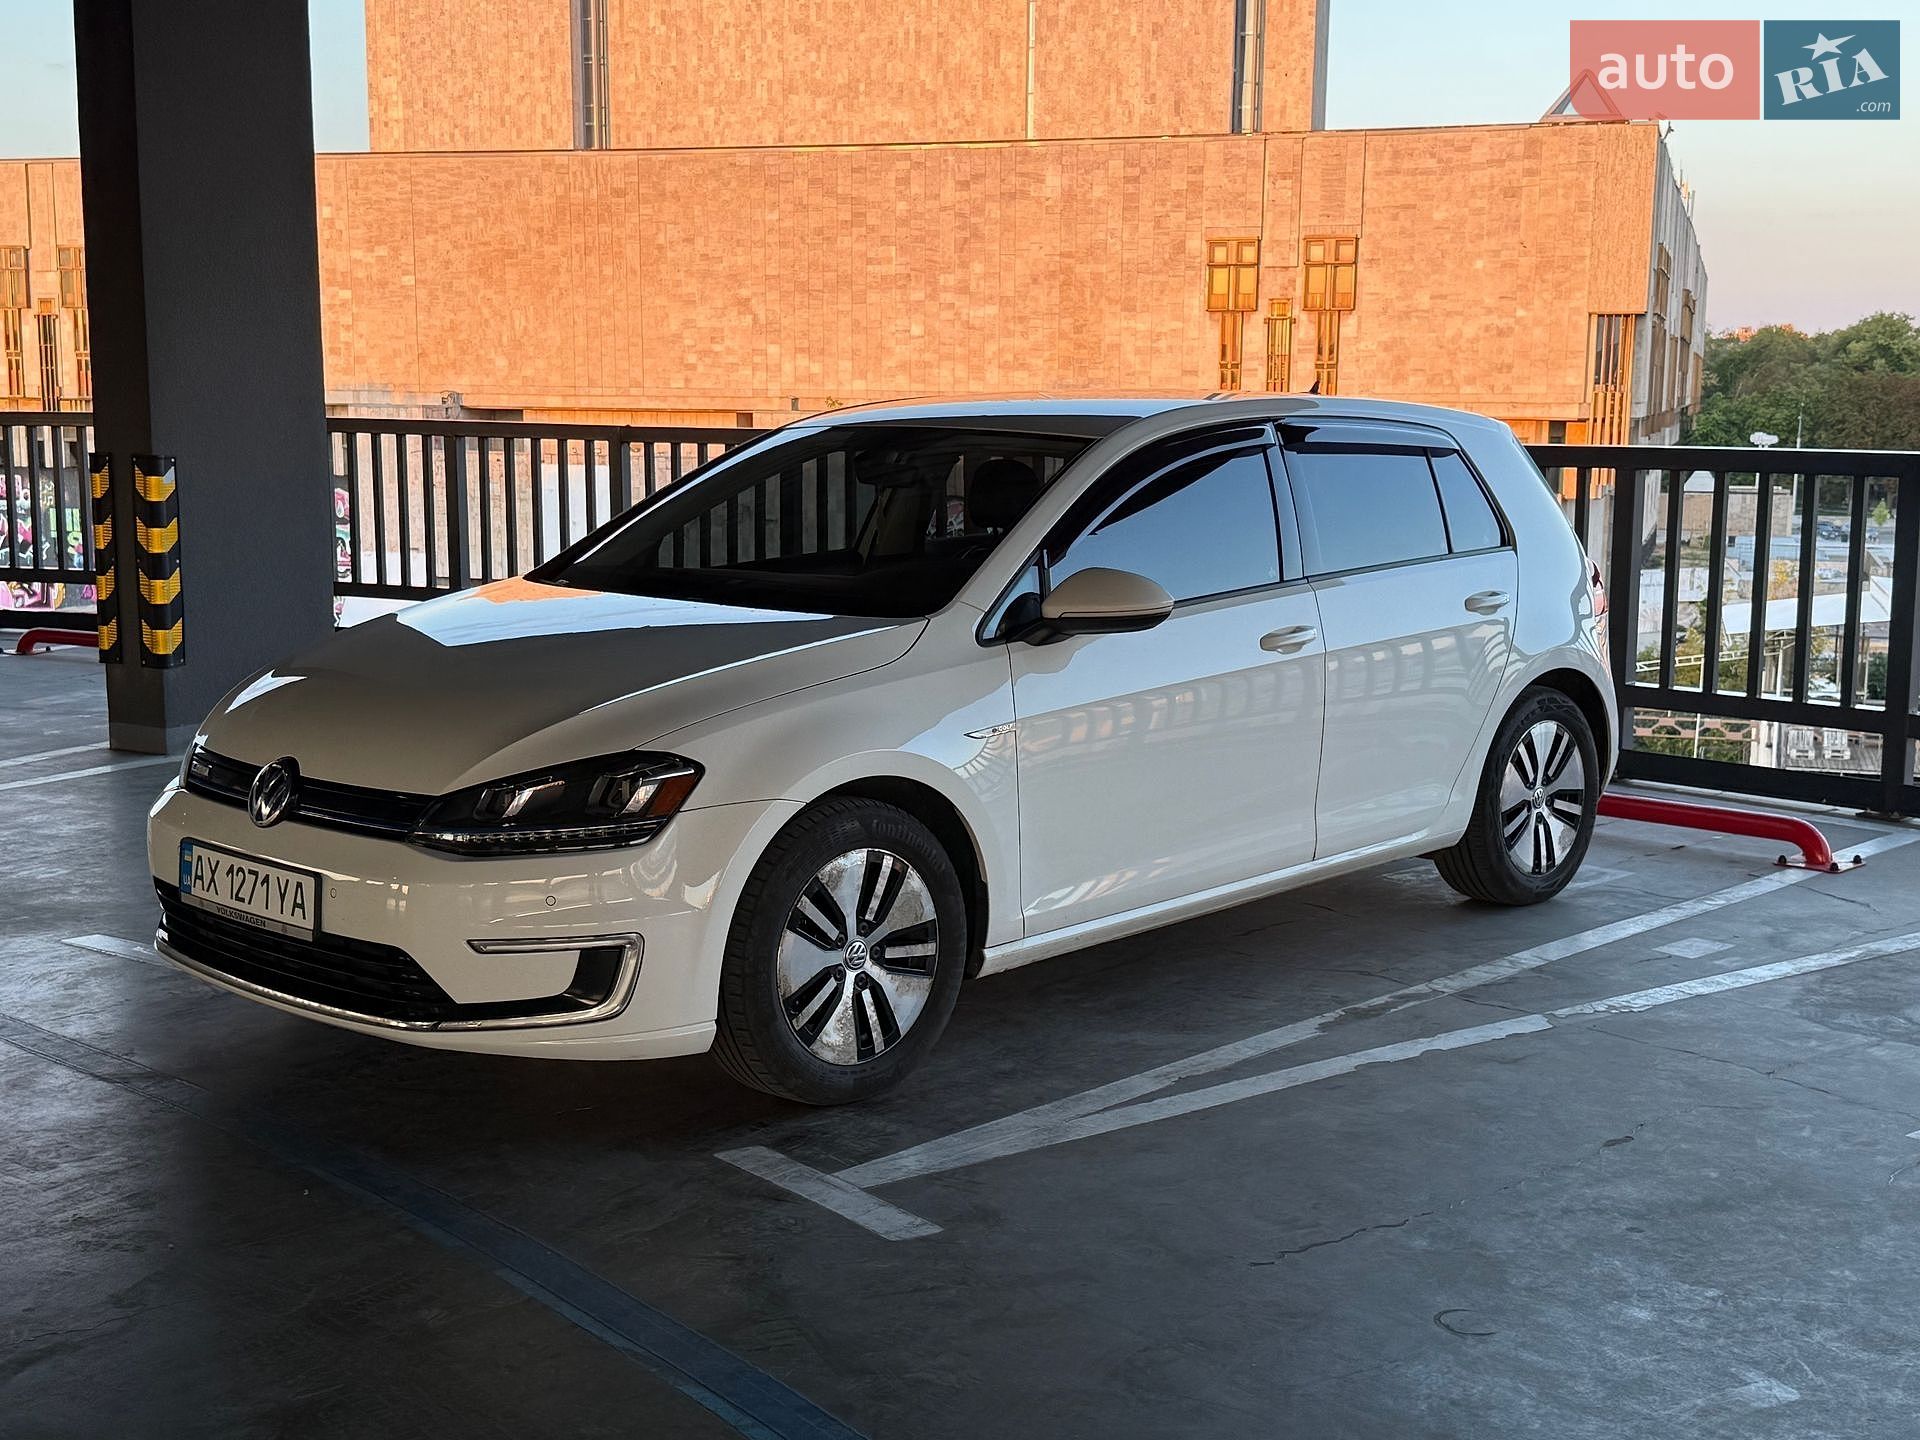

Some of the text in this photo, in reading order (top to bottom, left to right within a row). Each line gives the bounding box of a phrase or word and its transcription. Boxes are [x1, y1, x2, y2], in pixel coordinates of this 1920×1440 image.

[193, 854, 307, 921] AX 1271 YA
[215, 905, 267, 928] VOLKSWAGEN
